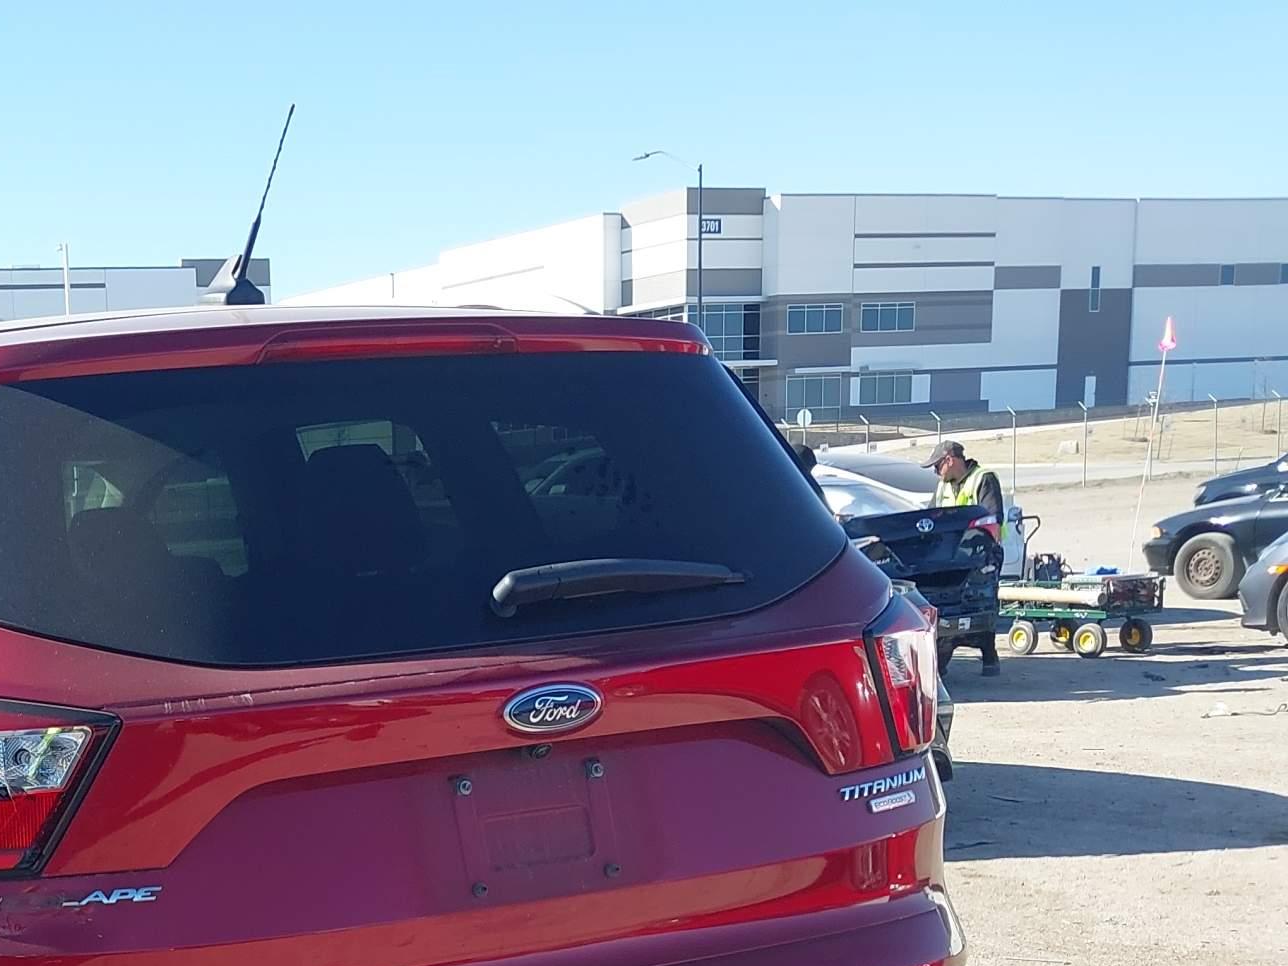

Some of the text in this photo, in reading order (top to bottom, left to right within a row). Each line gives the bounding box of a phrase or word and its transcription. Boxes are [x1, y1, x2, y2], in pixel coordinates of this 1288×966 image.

[701, 220, 719, 233] 3701
[529, 695, 581, 723] Ford
[840, 766, 926, 801] TITANIUM
